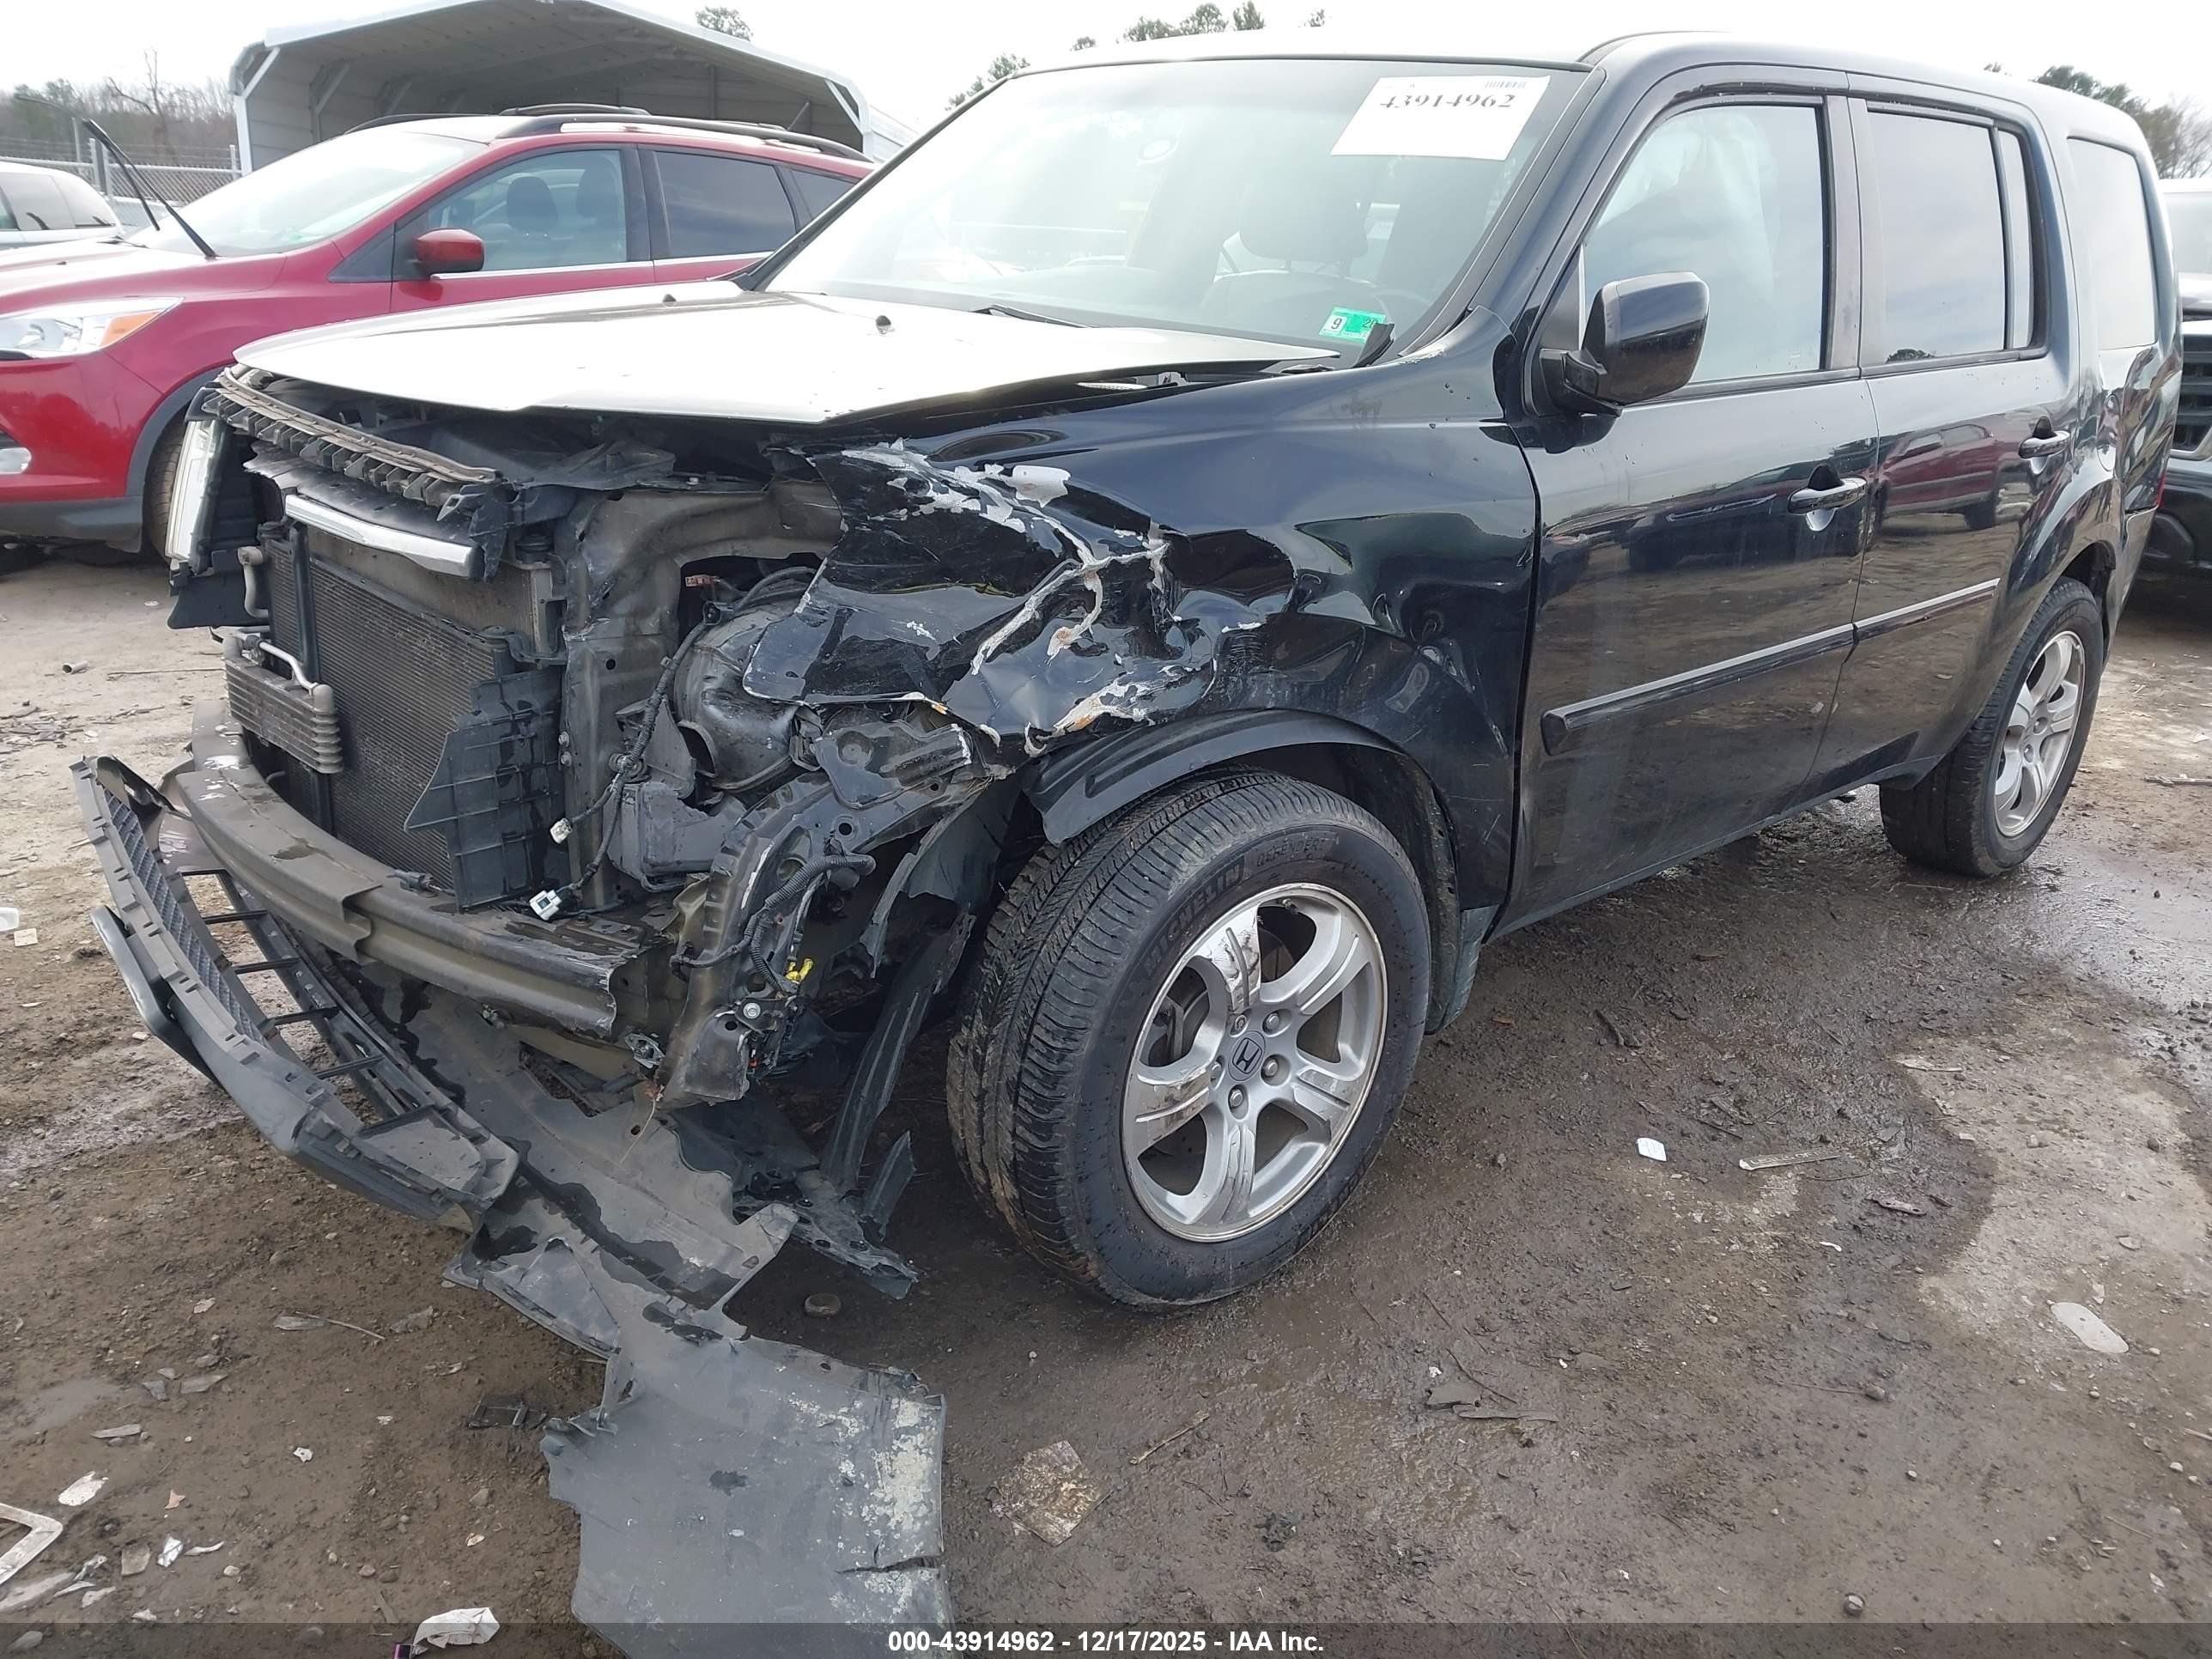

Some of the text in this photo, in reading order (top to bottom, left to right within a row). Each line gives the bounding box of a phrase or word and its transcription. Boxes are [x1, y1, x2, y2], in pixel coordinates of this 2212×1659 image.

[1380, 94, 1516, 109] 43914962
[1331, 318, 1343, 330] 9
[1143, 863, 1241, 977] MICHELIN
